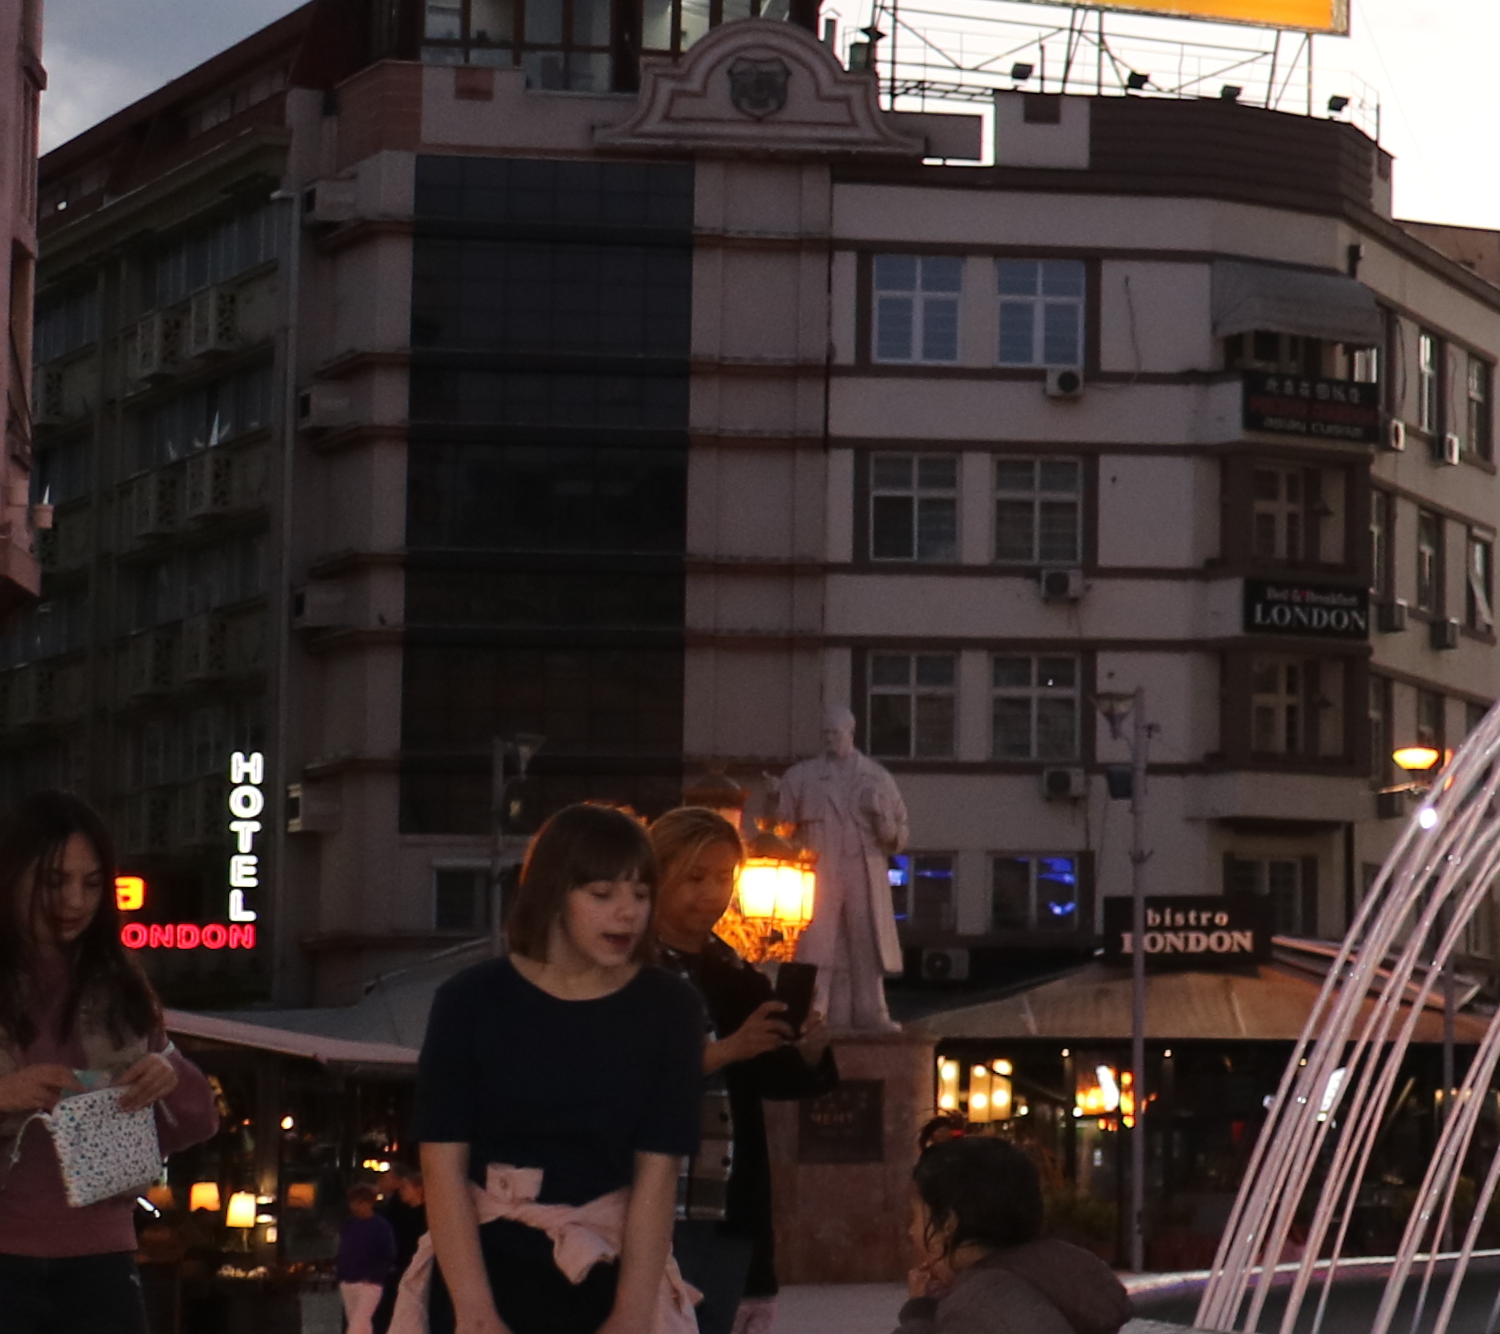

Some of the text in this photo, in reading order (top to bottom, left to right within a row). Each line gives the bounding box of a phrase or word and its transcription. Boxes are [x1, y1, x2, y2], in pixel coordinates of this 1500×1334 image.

[1254, 603, 1367, 632] LONDON
[229, 751, 264, 922] HOTEL
[1146, 907, 1230, 928] bistro
[121, 922, 257, 950] ONDON
